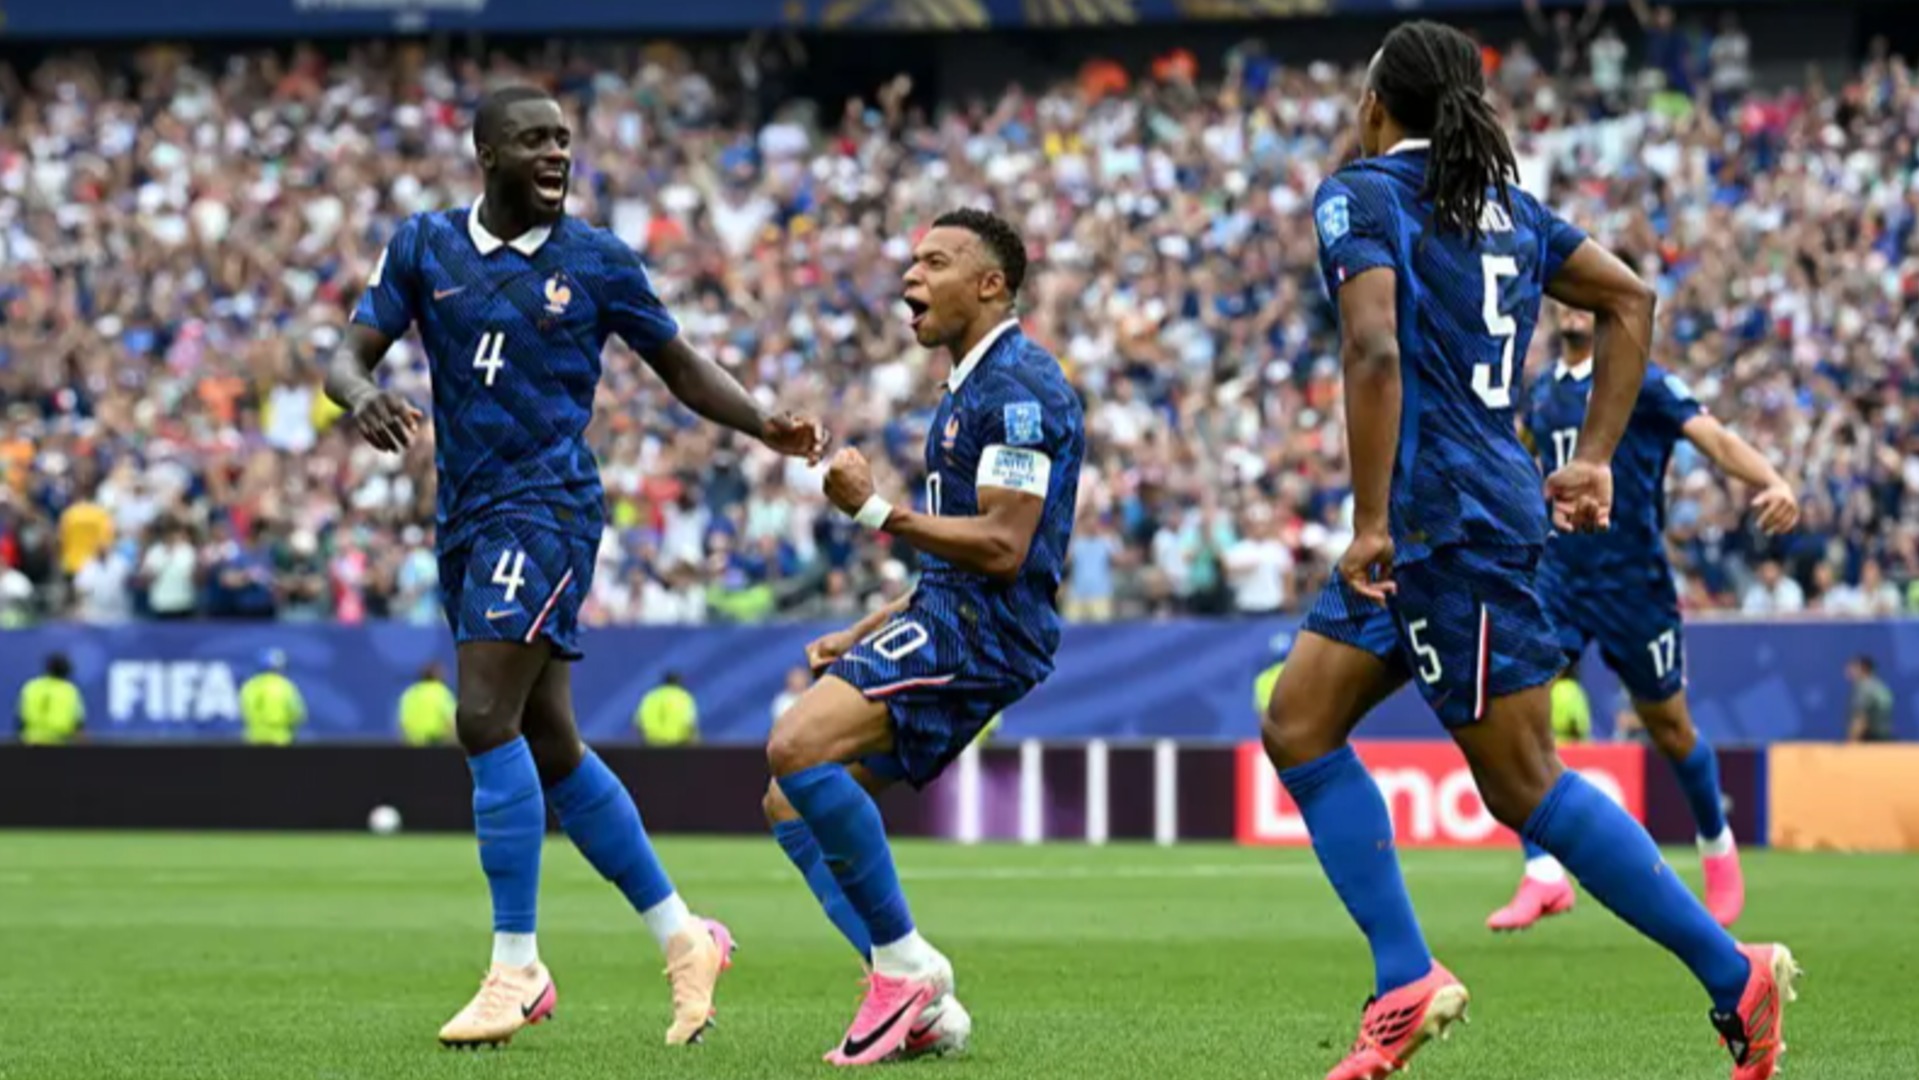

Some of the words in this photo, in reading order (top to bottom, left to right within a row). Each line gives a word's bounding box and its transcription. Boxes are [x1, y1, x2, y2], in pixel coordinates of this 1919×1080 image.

[473, 331, 505, 386] 4
[1470, 254, 1519, 409] 5
[1552, 428, 1578, 468] 17
[492, 549, 525, 602] 4
[1409, 618, 1442, 684] 5
[1647, 629, 1675, 678] 17
[108, 660, 239, 721] FIFA
[1254, 752, 1627, 839] Lno
